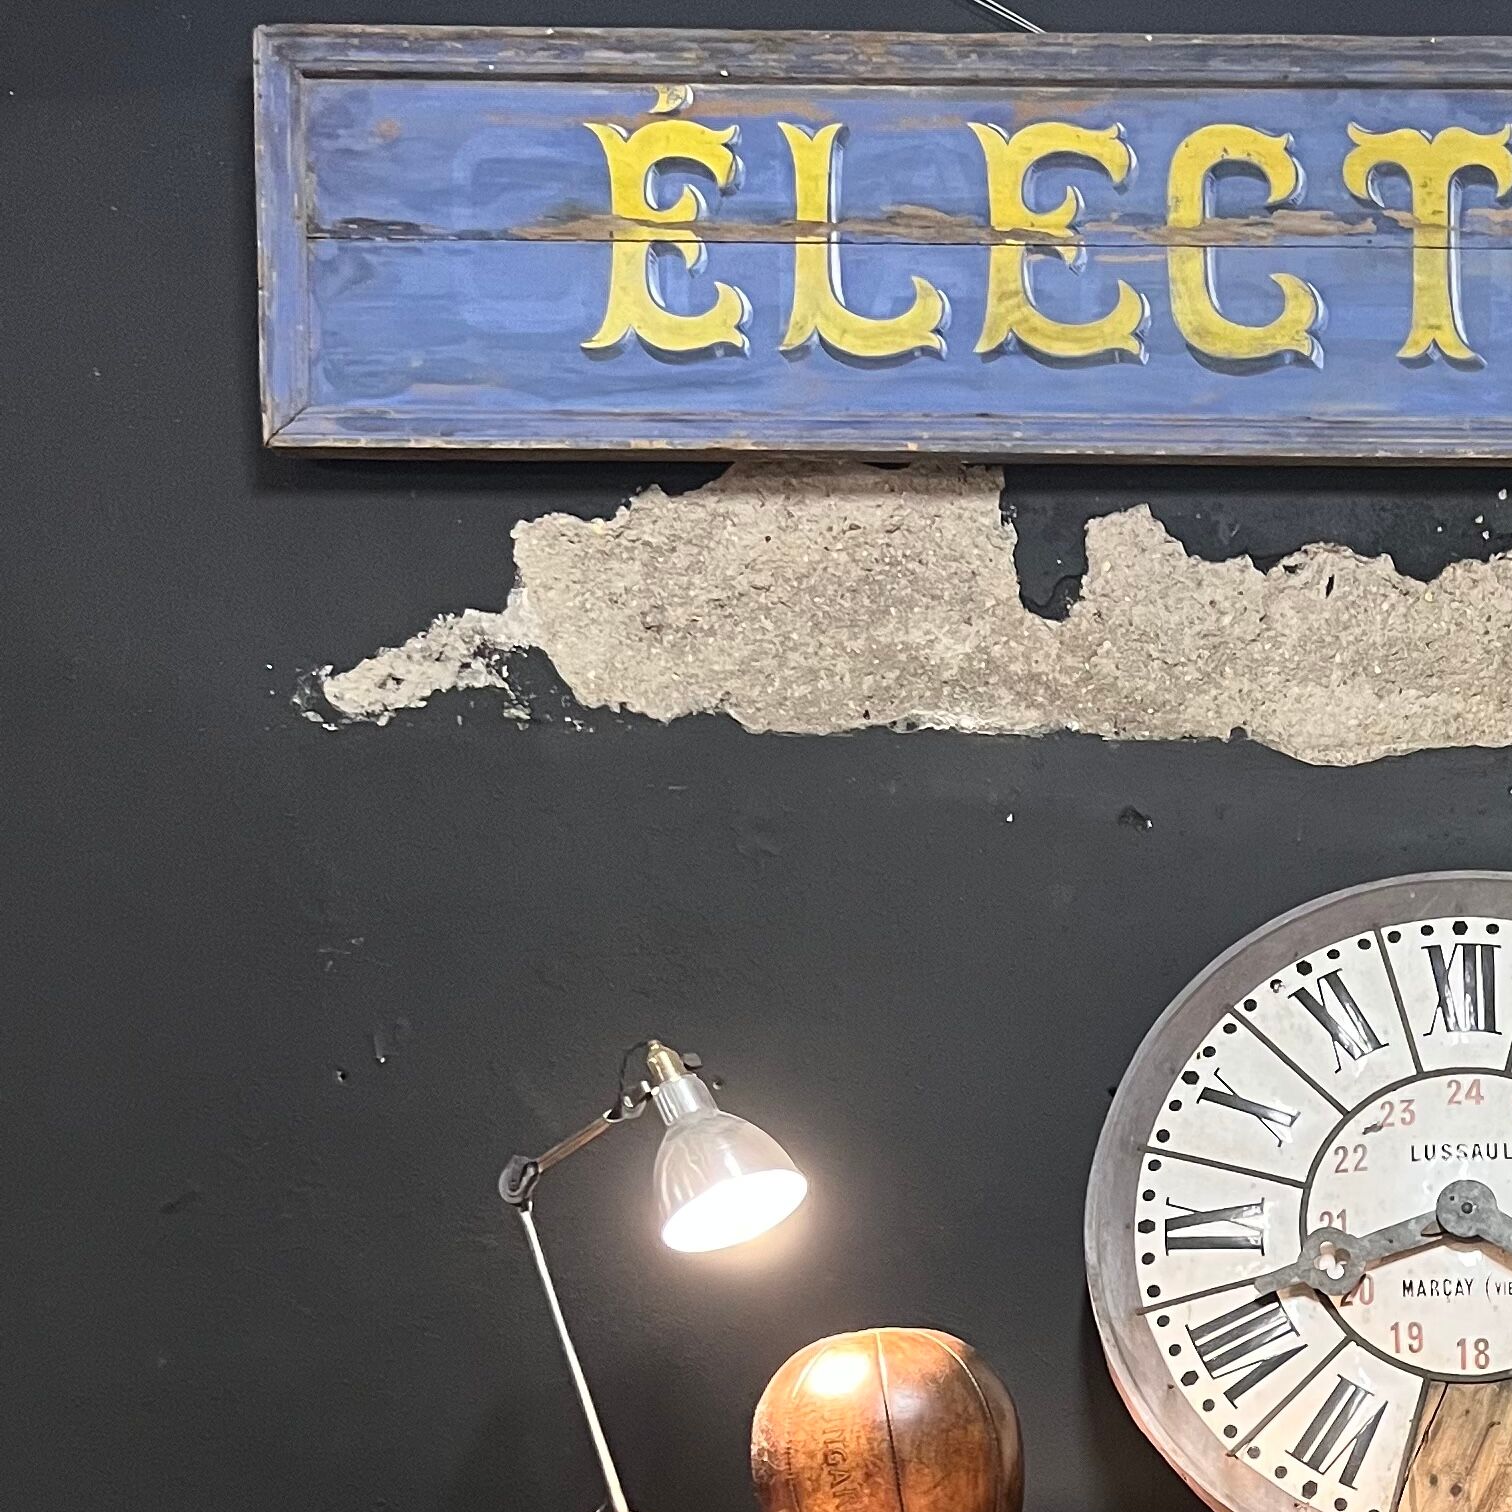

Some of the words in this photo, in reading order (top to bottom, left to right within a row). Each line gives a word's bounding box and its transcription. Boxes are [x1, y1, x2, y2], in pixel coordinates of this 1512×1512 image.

[1421, 943, 1503, 1037] XII
[1287, 968, 1390, 1074] XI
[1196, 1067, 1302, 1148] X
[1446, 1078, 1485, 1106] 24
[1379, 1098, 1417, 1128] 23
[1333, 1143, 1369, 1174] 22
[1402, 1277, 1475, 1303] MARÇAY
[1390, 1320, 1425, 1354] 19
[1456, 1337, 1491, 1371] 18
